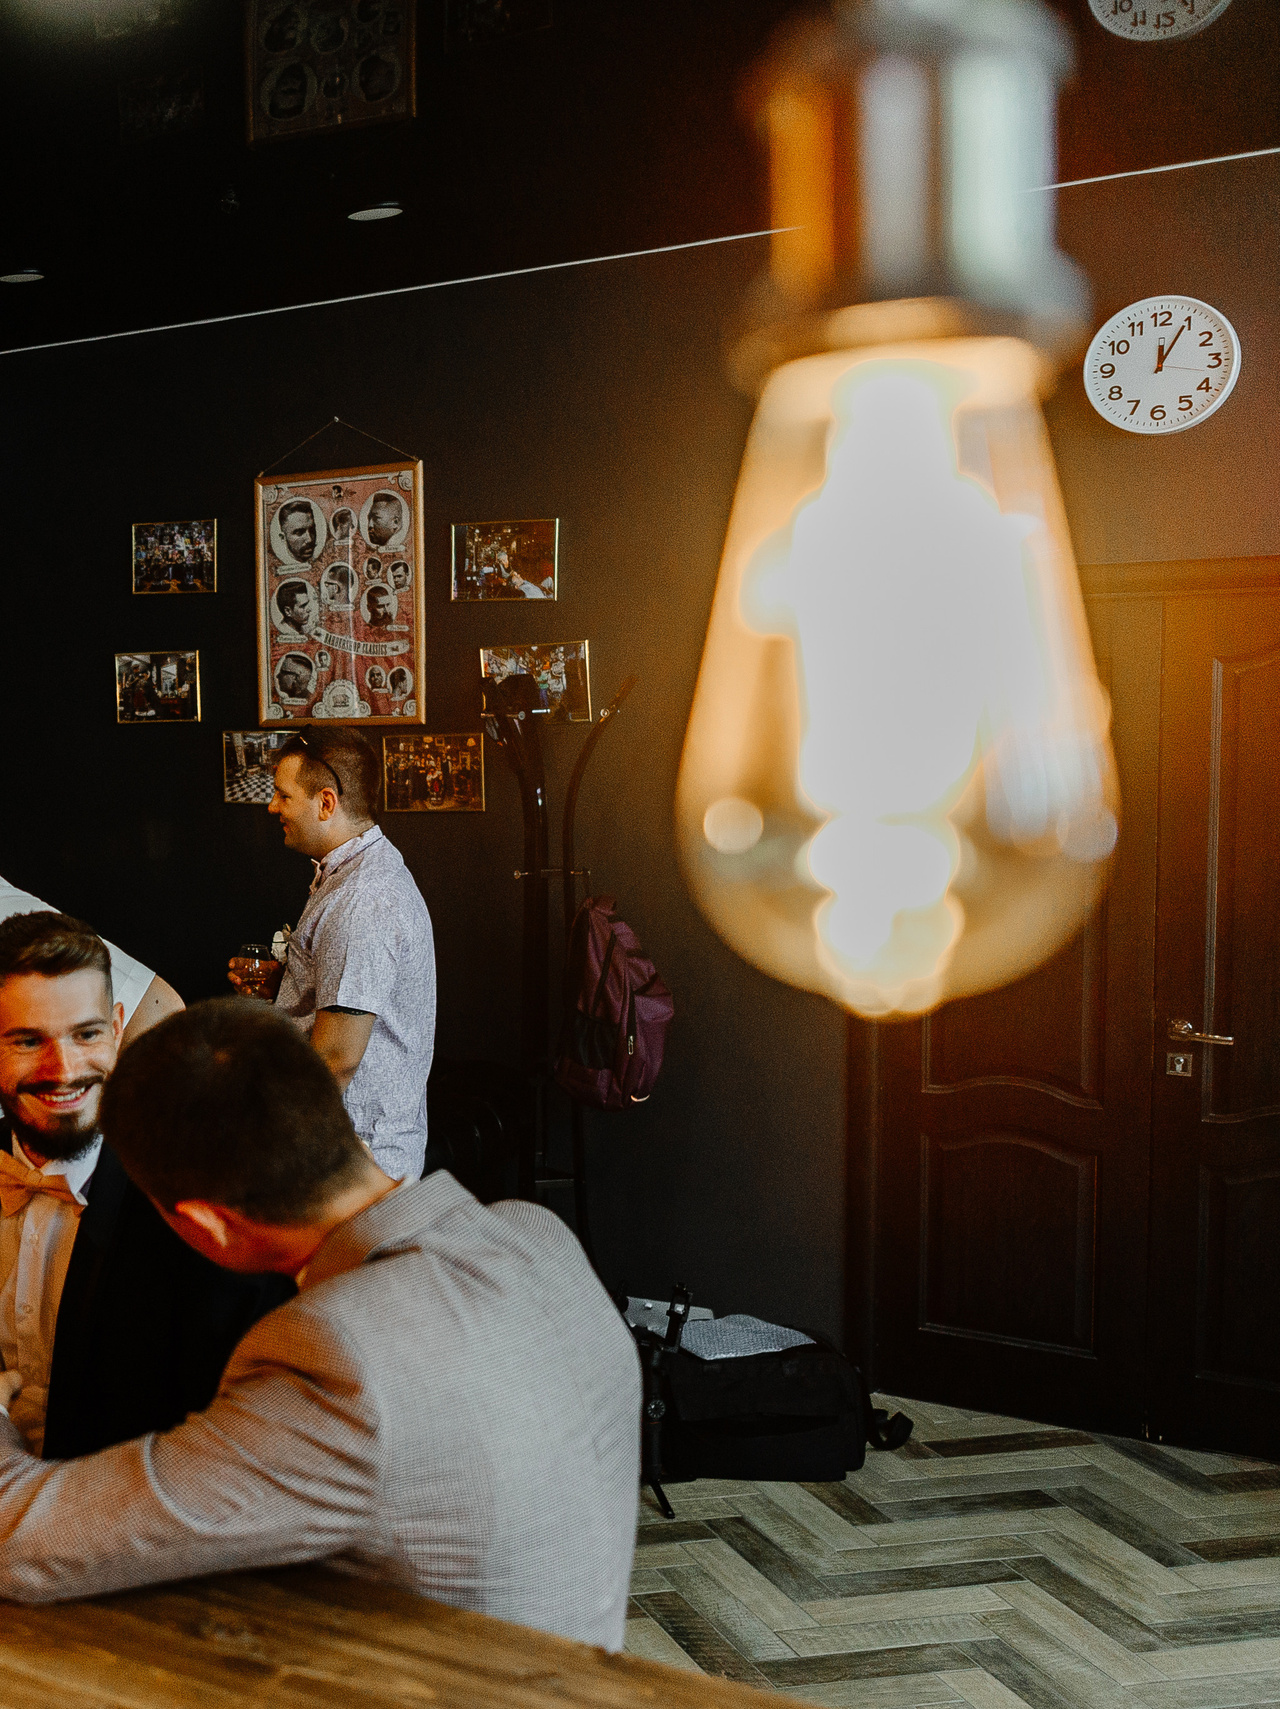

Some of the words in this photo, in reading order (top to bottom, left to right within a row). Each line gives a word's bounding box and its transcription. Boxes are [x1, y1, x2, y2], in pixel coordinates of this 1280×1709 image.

[1150, 311, 1173, 327] 12
[1184, 316, 1192, 331] 1
[1128, 321, 1144, 337] 11
[1198, 331, 1213, 347] 2
[1108, 339, 1130, 356] 10
[1206, 352, 1222, 369] 3
[1100, 363, 1115, 379] 9
[1108, 385, 1123, 401] 8
[1196, 377, 1212, 393] 4
[1127, 399, 1141, 415] 7
[1177, 395, 1193, 411] 5
[1150, 405, 1166, 420] 6
[362, 643, 387, 656] CLASSICS
